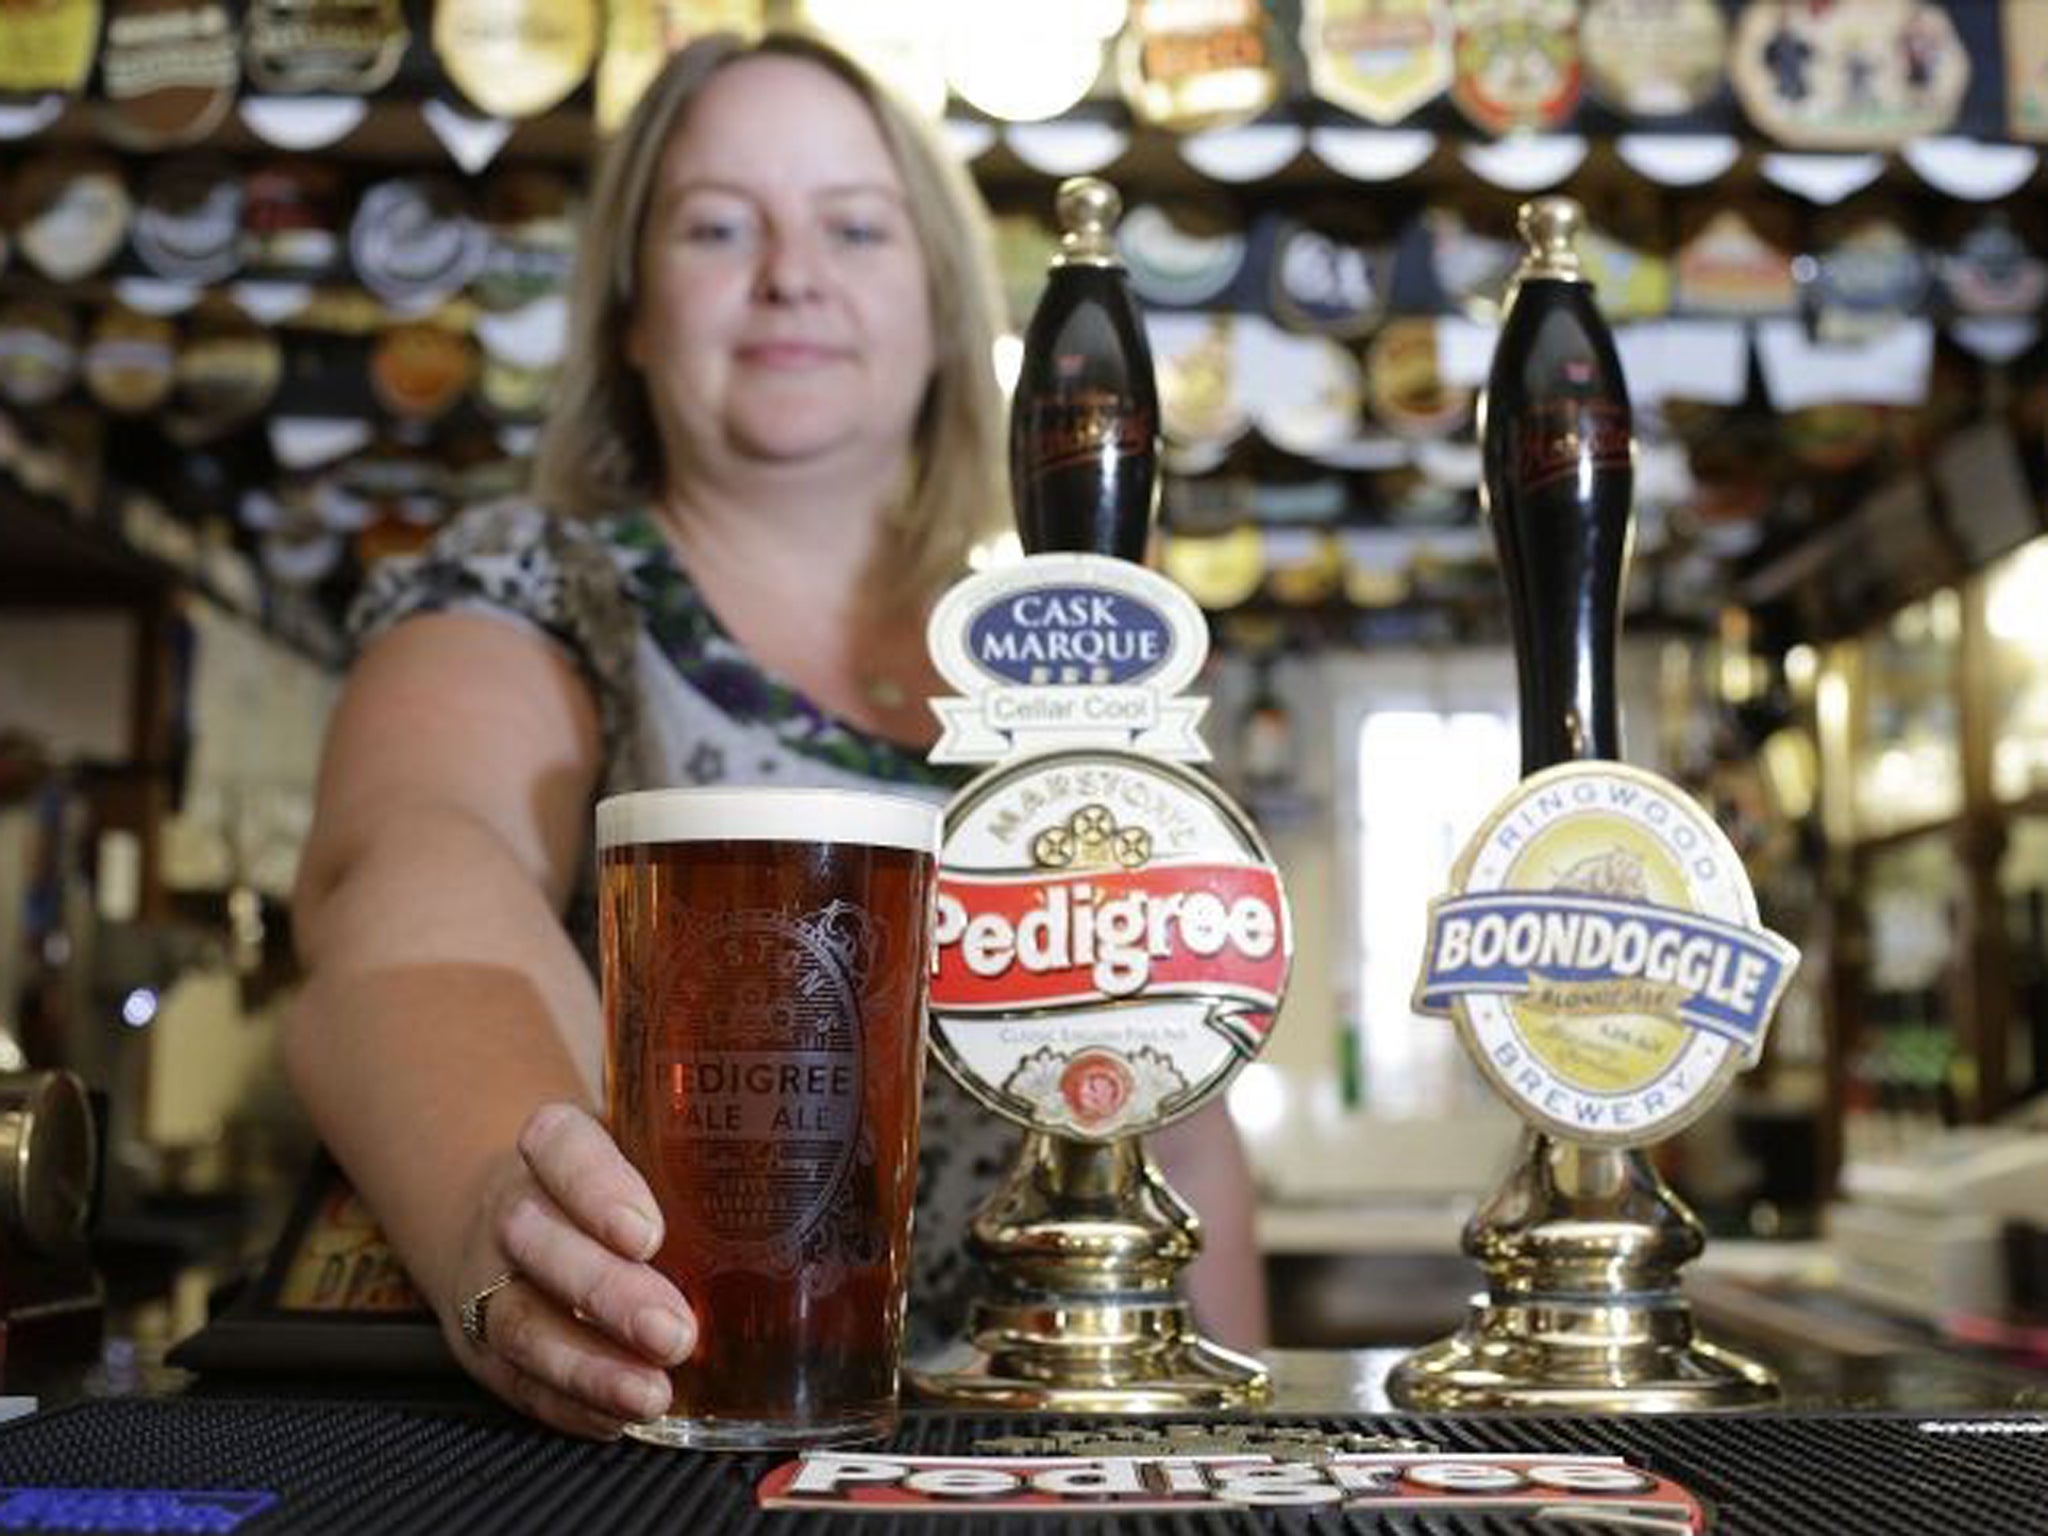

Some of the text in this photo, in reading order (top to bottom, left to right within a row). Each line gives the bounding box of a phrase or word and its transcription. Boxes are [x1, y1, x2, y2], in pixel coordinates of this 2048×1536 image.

[1012, 597, 1119, 628] CASK
[981, 629, 1162, 662] MARQUE
[993, 696, 1073, 722] Cellar
[1498, 781, 1717, 882] RINGWOOD
[930, 882, 1277, 997] Pedigree
[1434, 911, 1768, 1014] BOONDOGGLE
[1493, 1040, 1690, 1126] BREWERY
[667, 1103, 832, 1132] ALE ALE
[792, 1455, 1662, 1506] Pedigree
